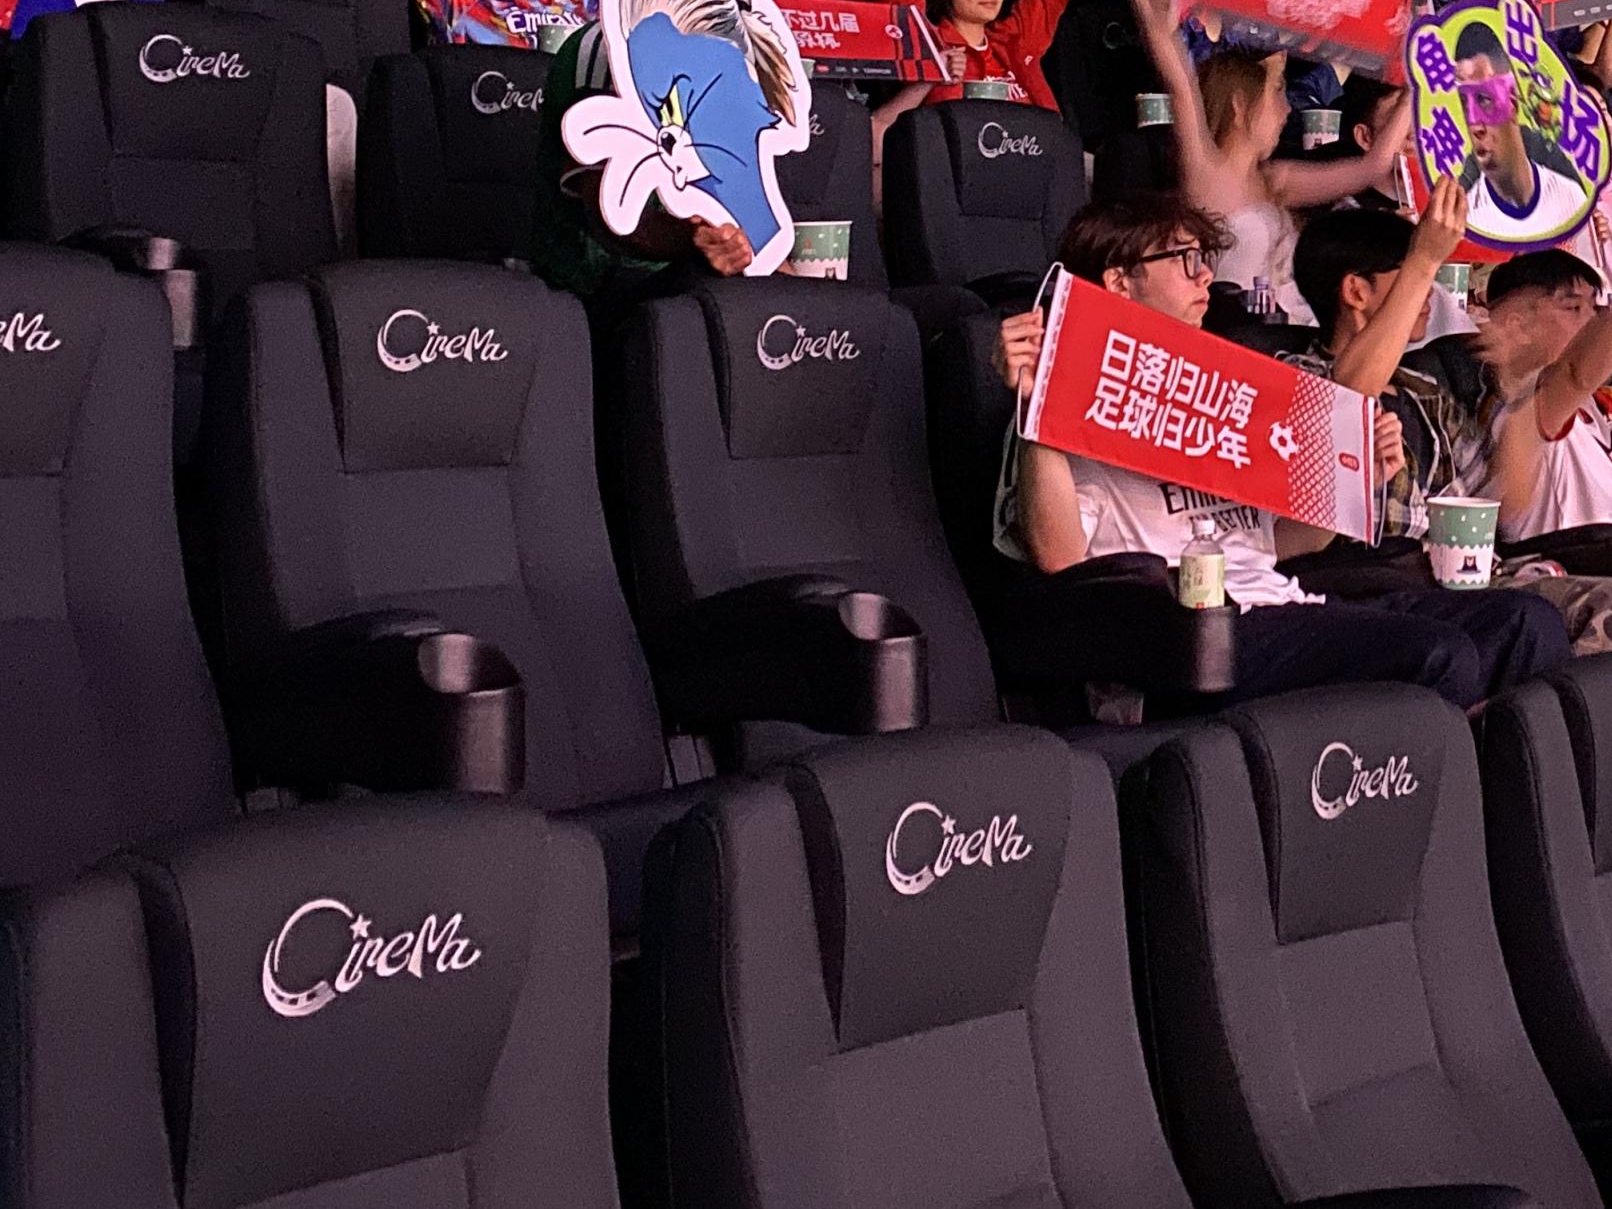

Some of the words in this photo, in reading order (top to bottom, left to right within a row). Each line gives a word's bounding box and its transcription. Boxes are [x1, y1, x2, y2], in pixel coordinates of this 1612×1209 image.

[1084, 376, 1252, 470] 足球归少年
[1099, 328, 1259, 429] 日落归山海
